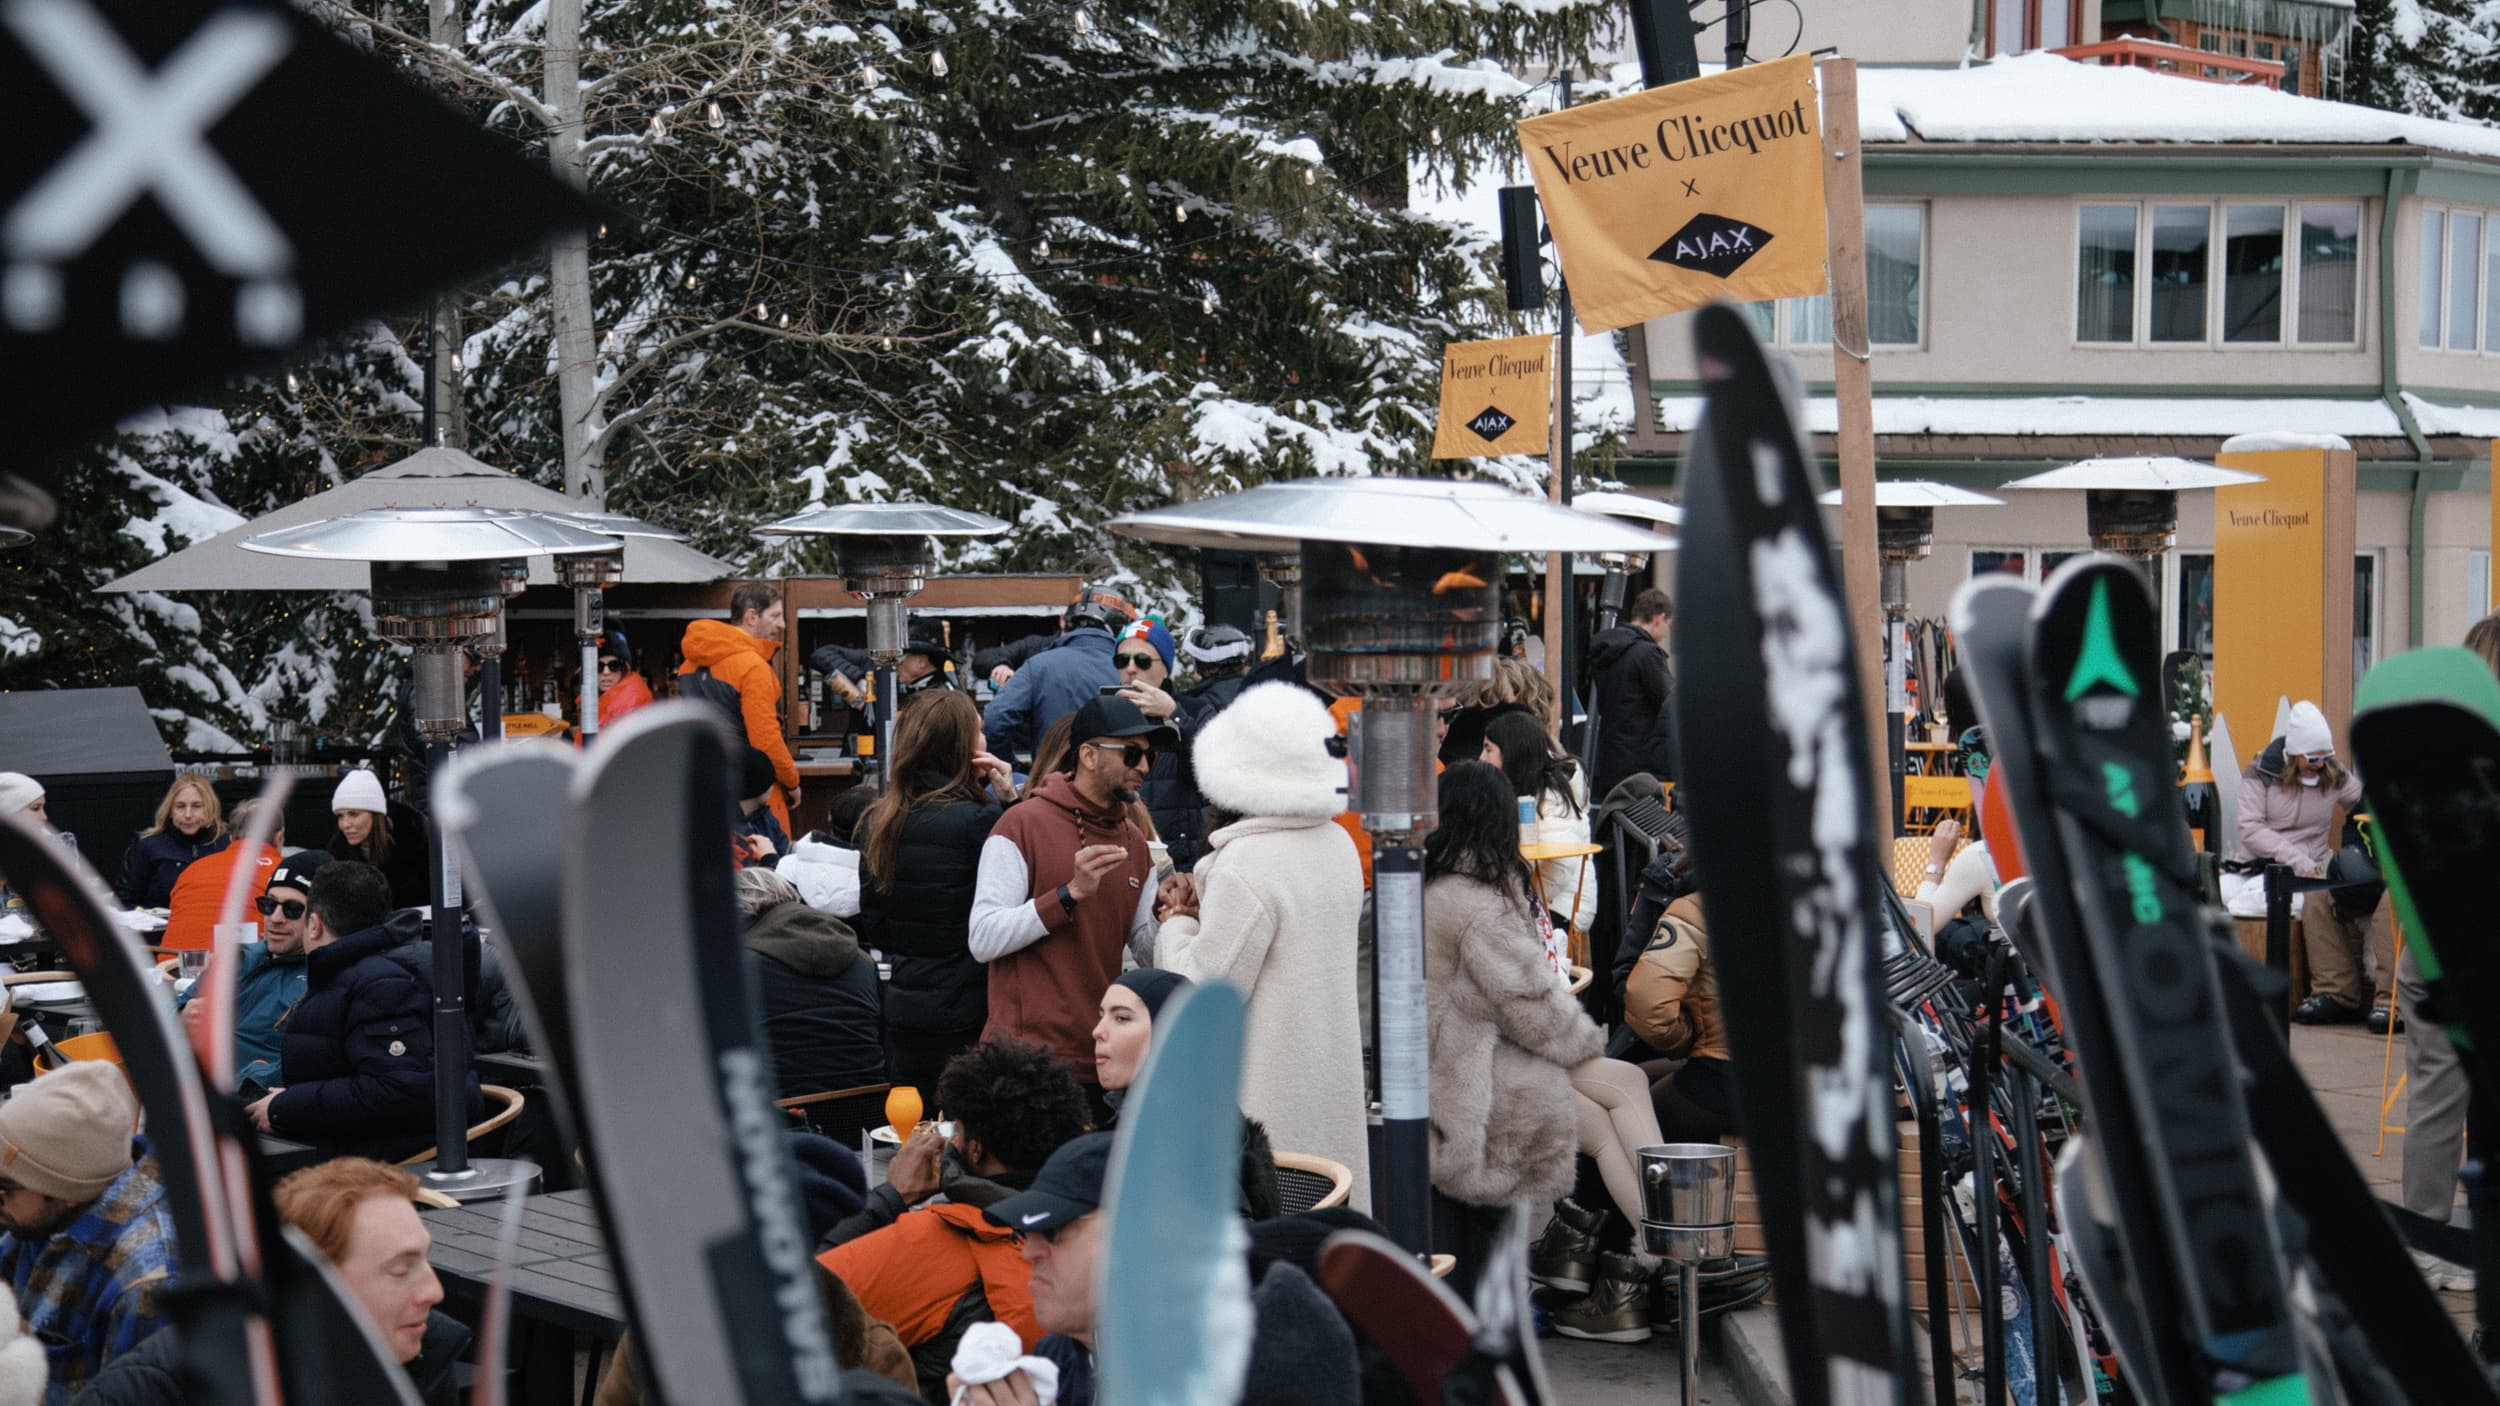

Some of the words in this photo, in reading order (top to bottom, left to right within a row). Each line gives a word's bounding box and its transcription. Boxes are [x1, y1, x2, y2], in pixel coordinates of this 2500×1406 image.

[1543, 141, 1652, 186] Veuve
[1656, 99, 1811, 162] Clicquot
[1675, 226, 1753, 260] AJAX
[1450, 358, 1486, 381] Veuve
[1488, 352, 1545, 380] Clicquot
[1474, 415, 1508, 432] AJAX
[2229, 509, 2260, 527] Veuve
[2262, 508, 2310, 529] Clicquot
